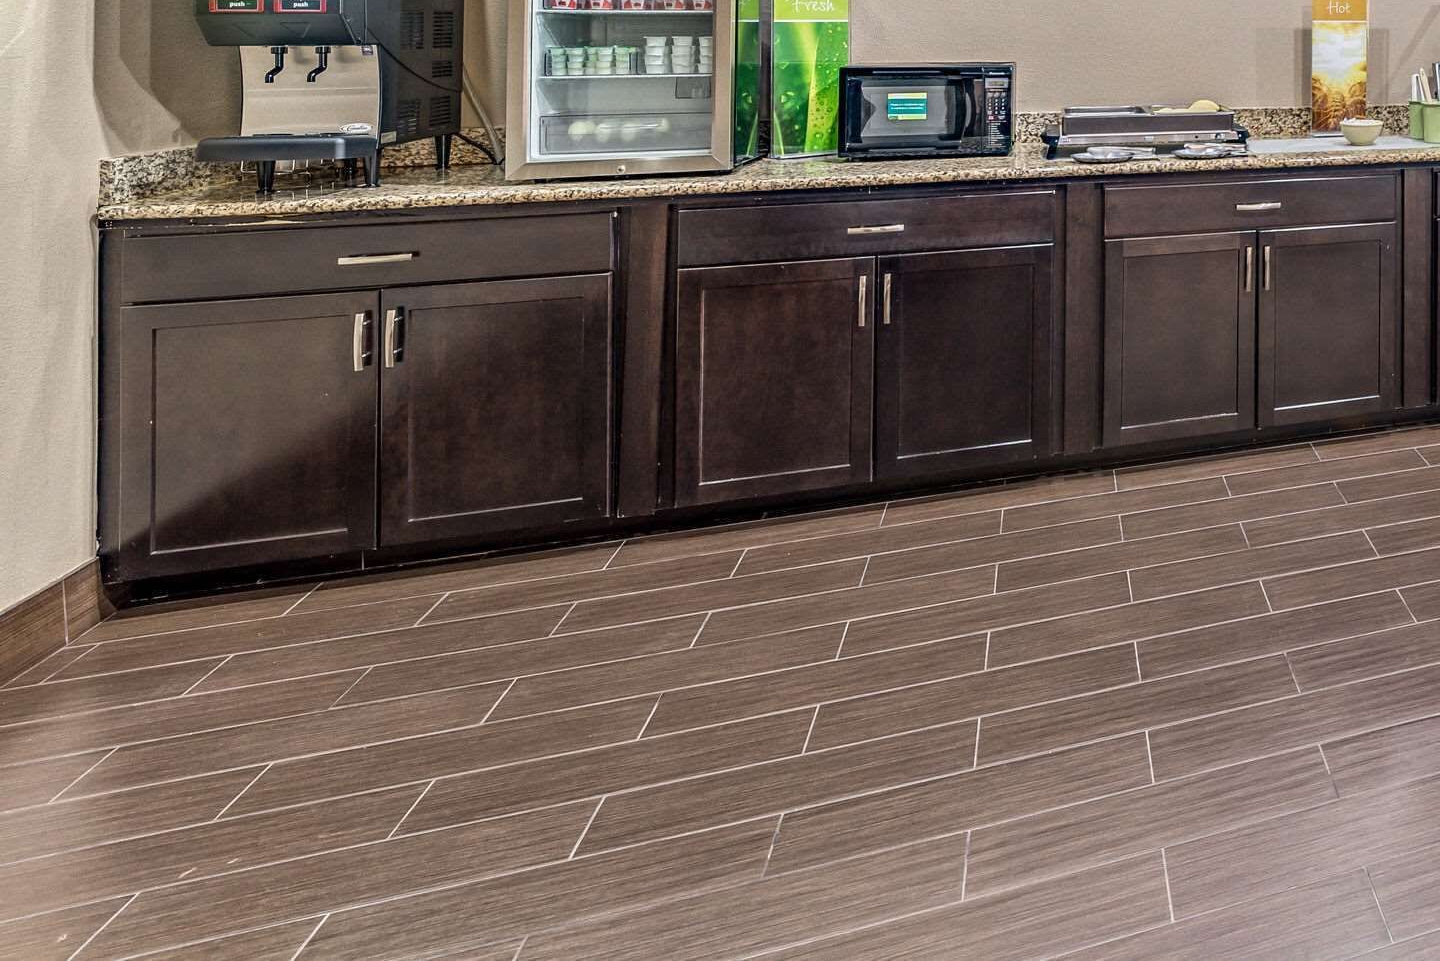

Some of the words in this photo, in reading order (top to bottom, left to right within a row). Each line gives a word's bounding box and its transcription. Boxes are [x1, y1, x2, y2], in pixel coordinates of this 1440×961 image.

[229, 0, 246, 8] push
[293, 0, 309, 8] push
[1327, 0, 1351, 15] Hot
